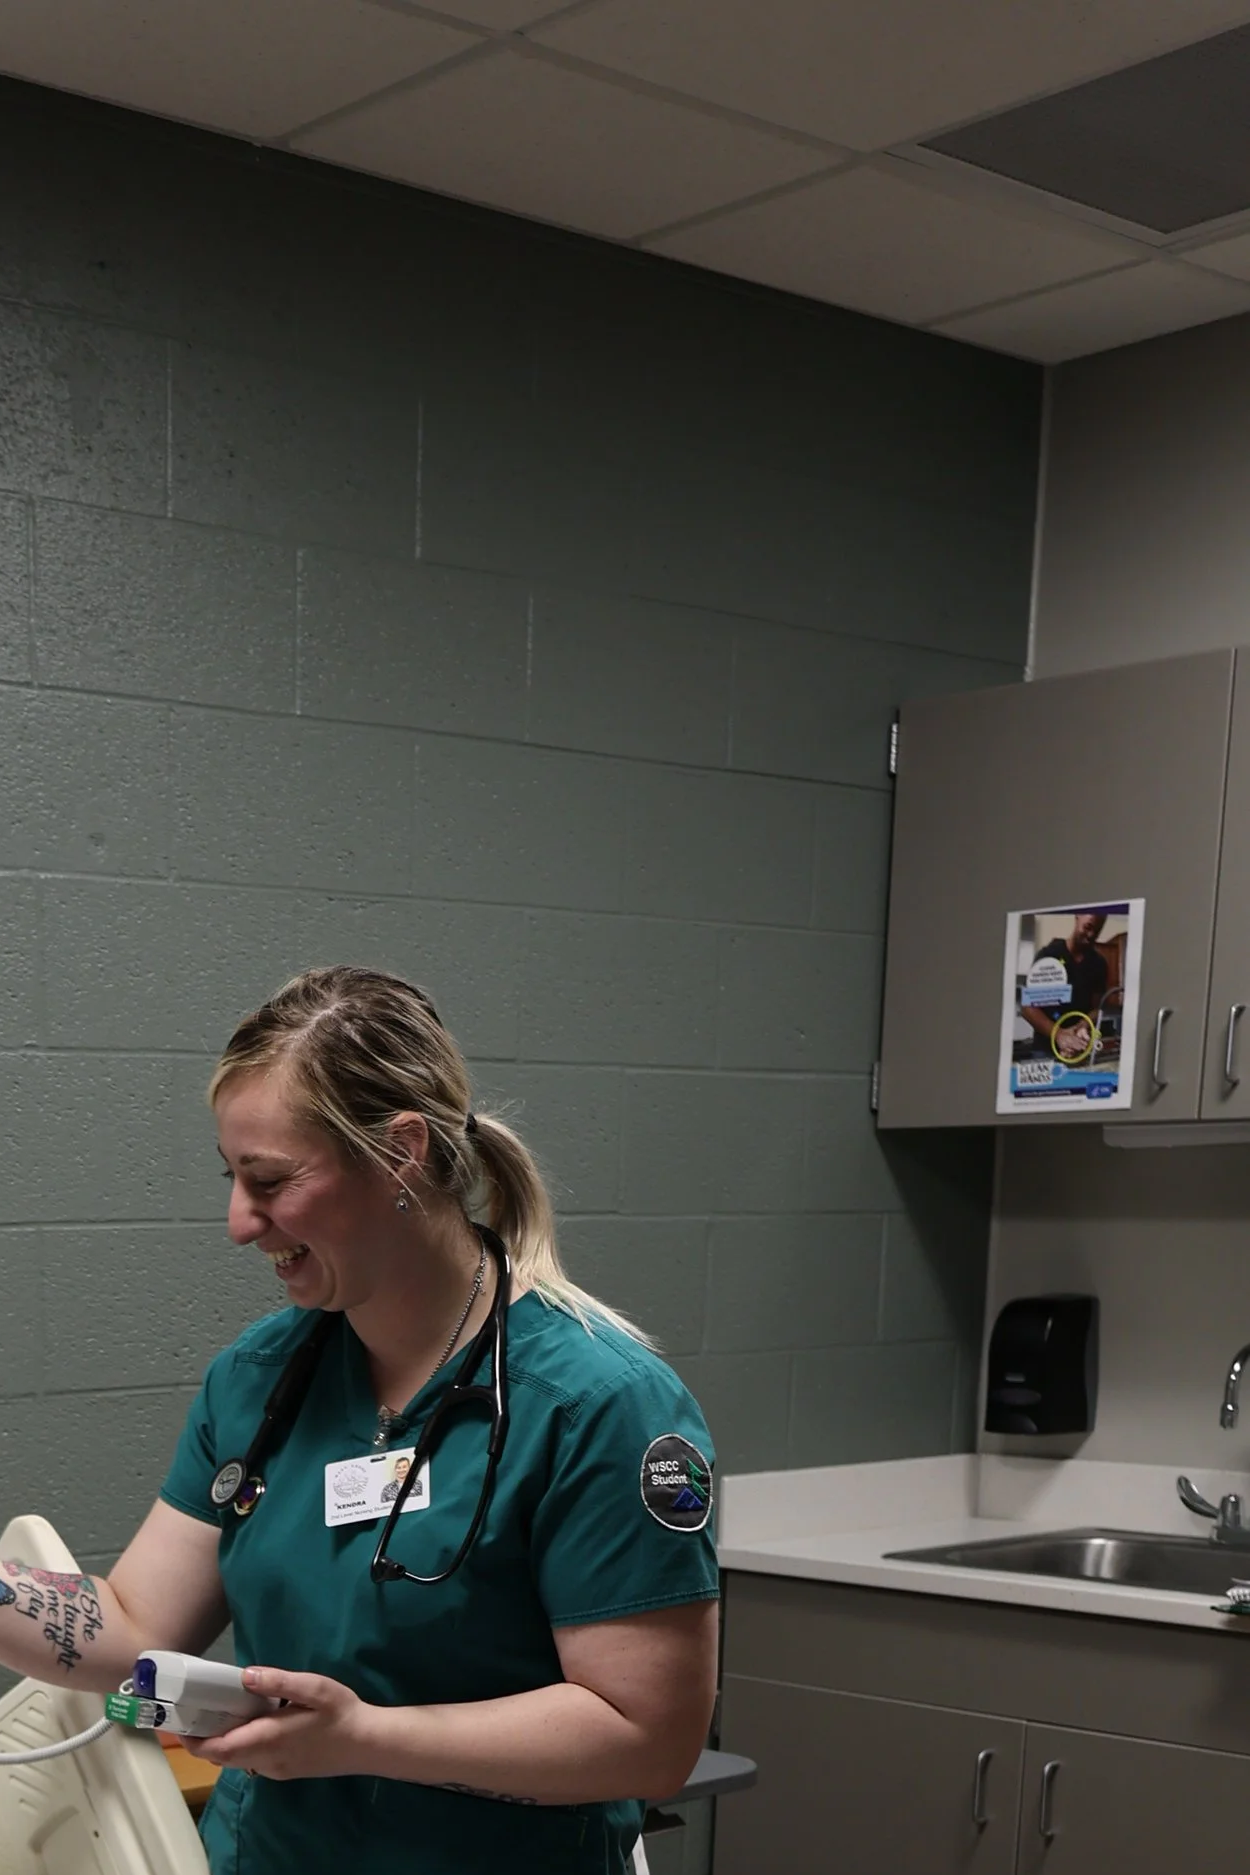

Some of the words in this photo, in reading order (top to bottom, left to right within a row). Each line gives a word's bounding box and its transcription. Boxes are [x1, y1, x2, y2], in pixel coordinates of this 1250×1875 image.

[648, 1460, 679, 1473] WSCC
[651, 1474, 688, 1486] Student
[337, 1500, 367, 1510] KENDRA
[15, 1582, 45, 1620] fly
[46, 1589, 59, 1618] me
[43, 1620, 62, 1642] to
[80, 1594, 104, 1643] She
[54, 1601, 82, 1674] taught
